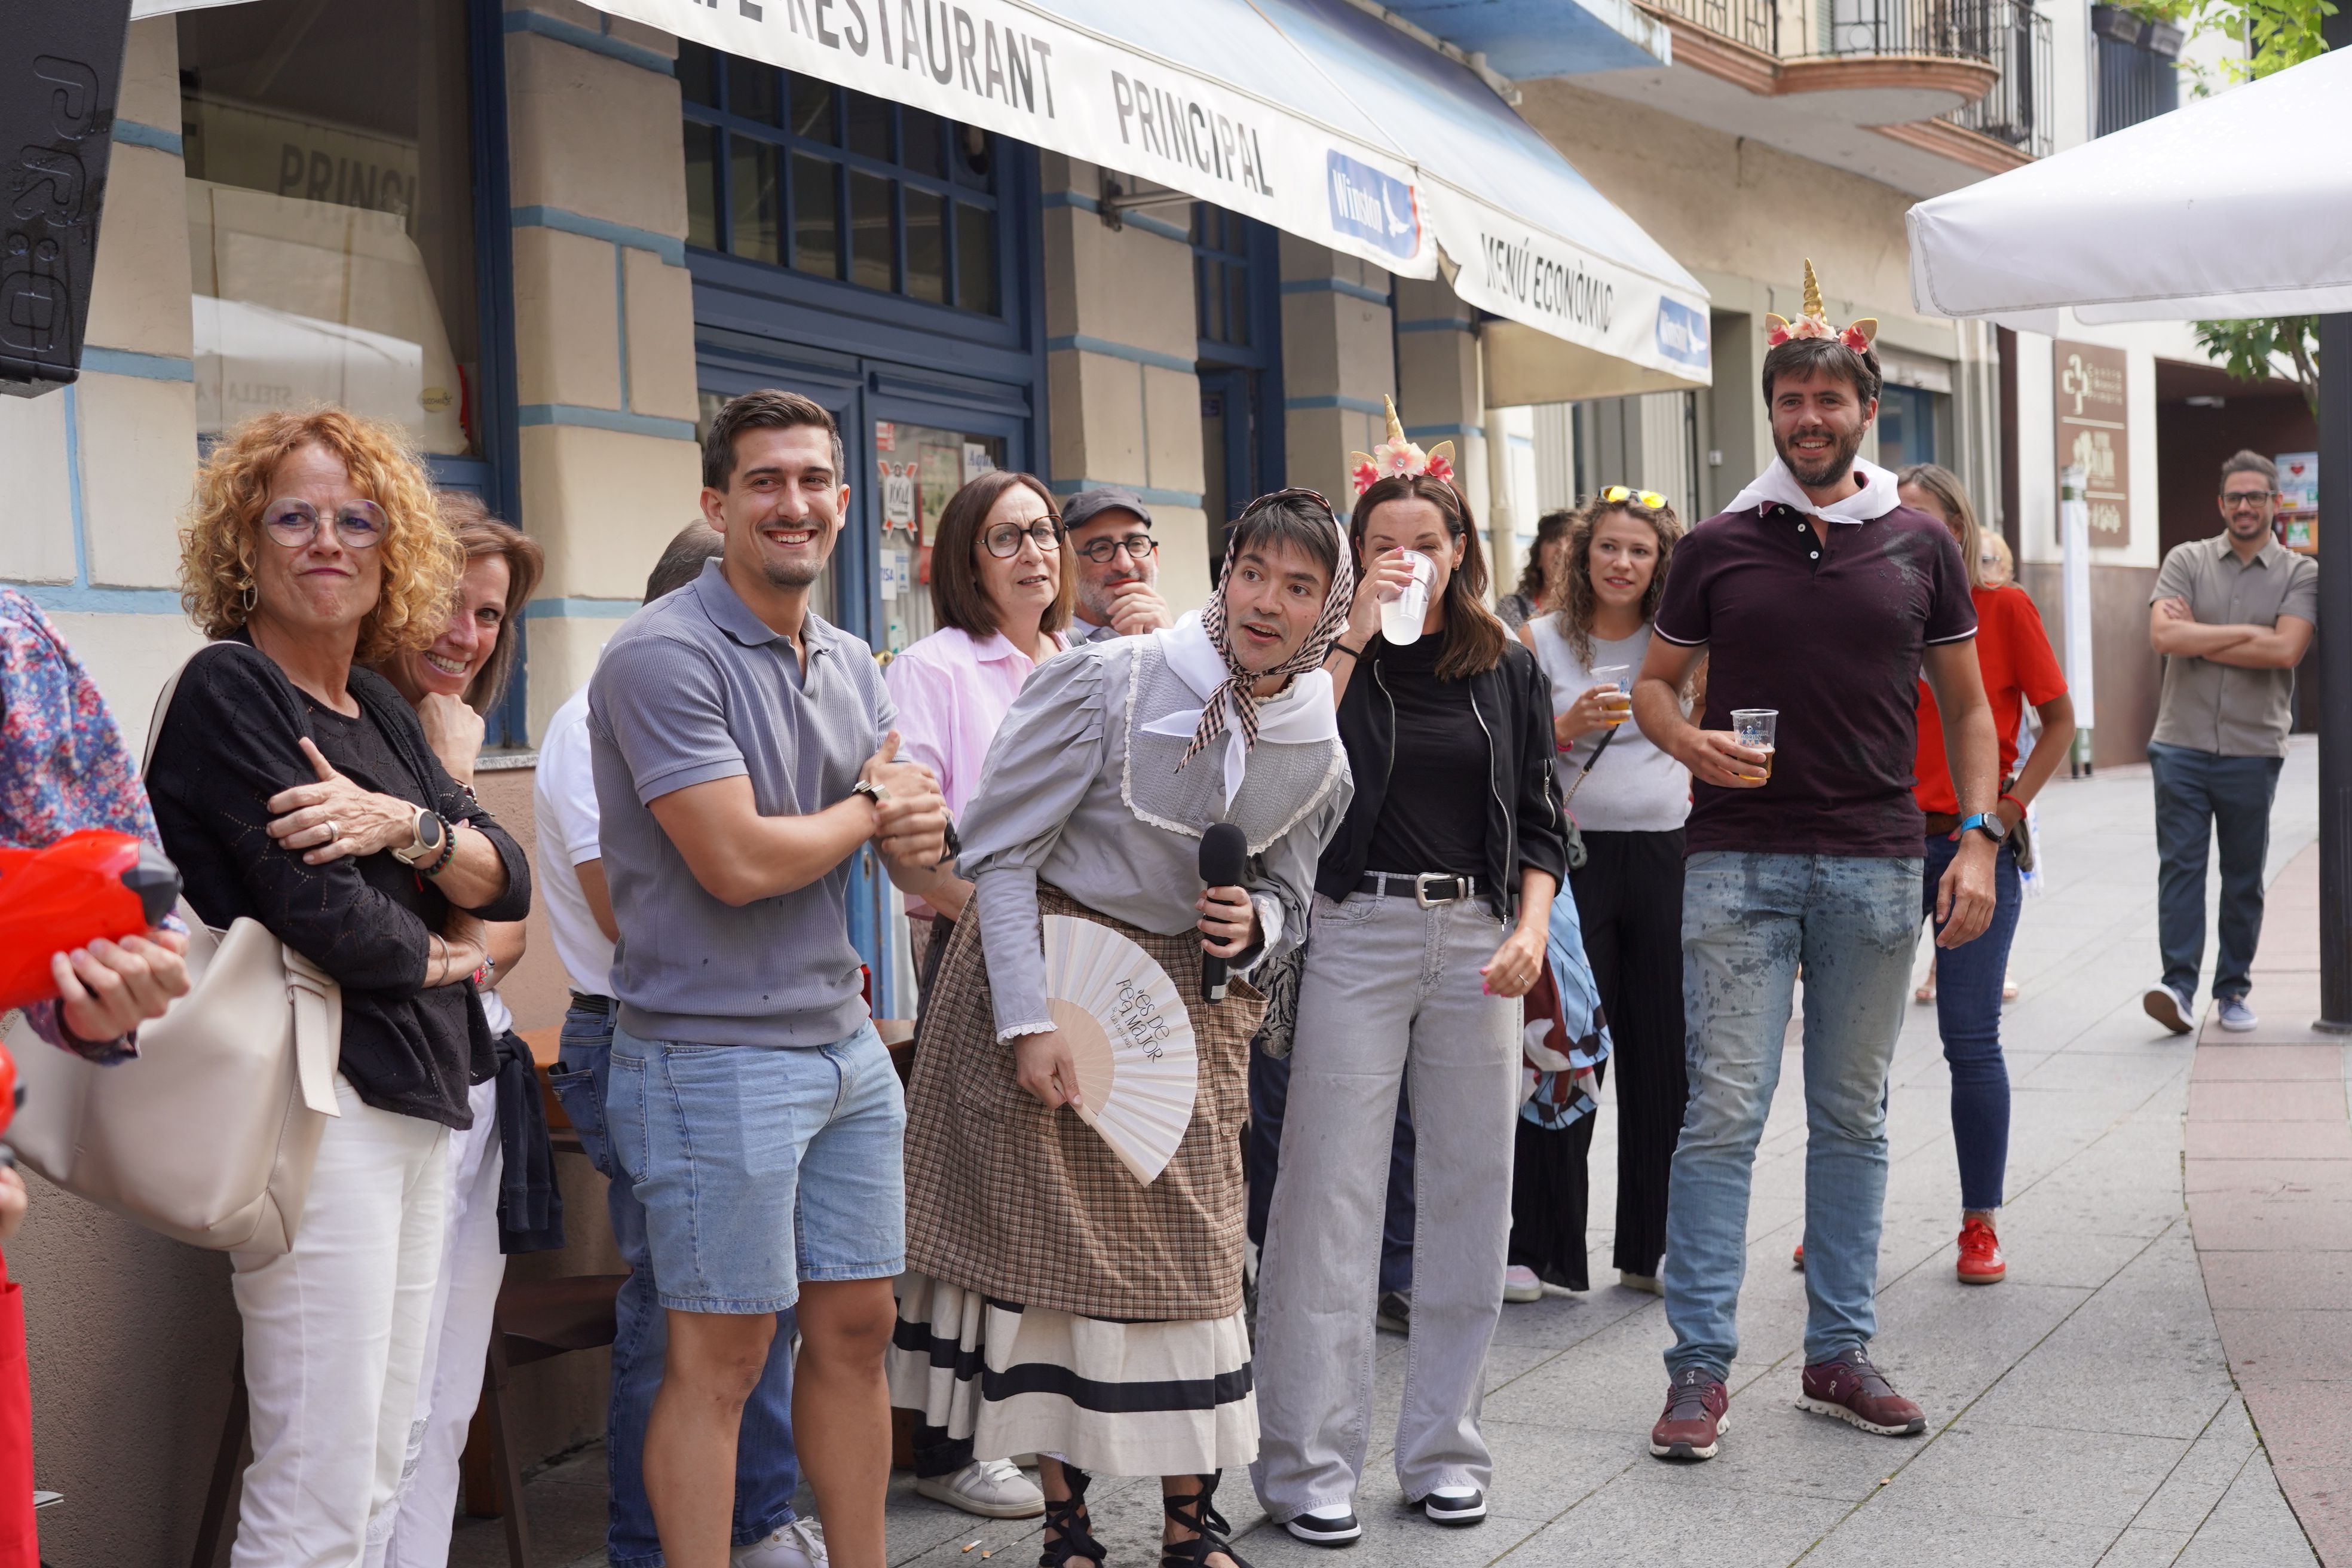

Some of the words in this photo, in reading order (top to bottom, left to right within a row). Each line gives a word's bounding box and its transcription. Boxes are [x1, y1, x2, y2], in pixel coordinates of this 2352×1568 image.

[1111, 70, 1273, 198] PRINCIPAL
[1481, 233, 1529, 304] MENÚ
[1534, 256, 1613, 333] ECONÒMIC
